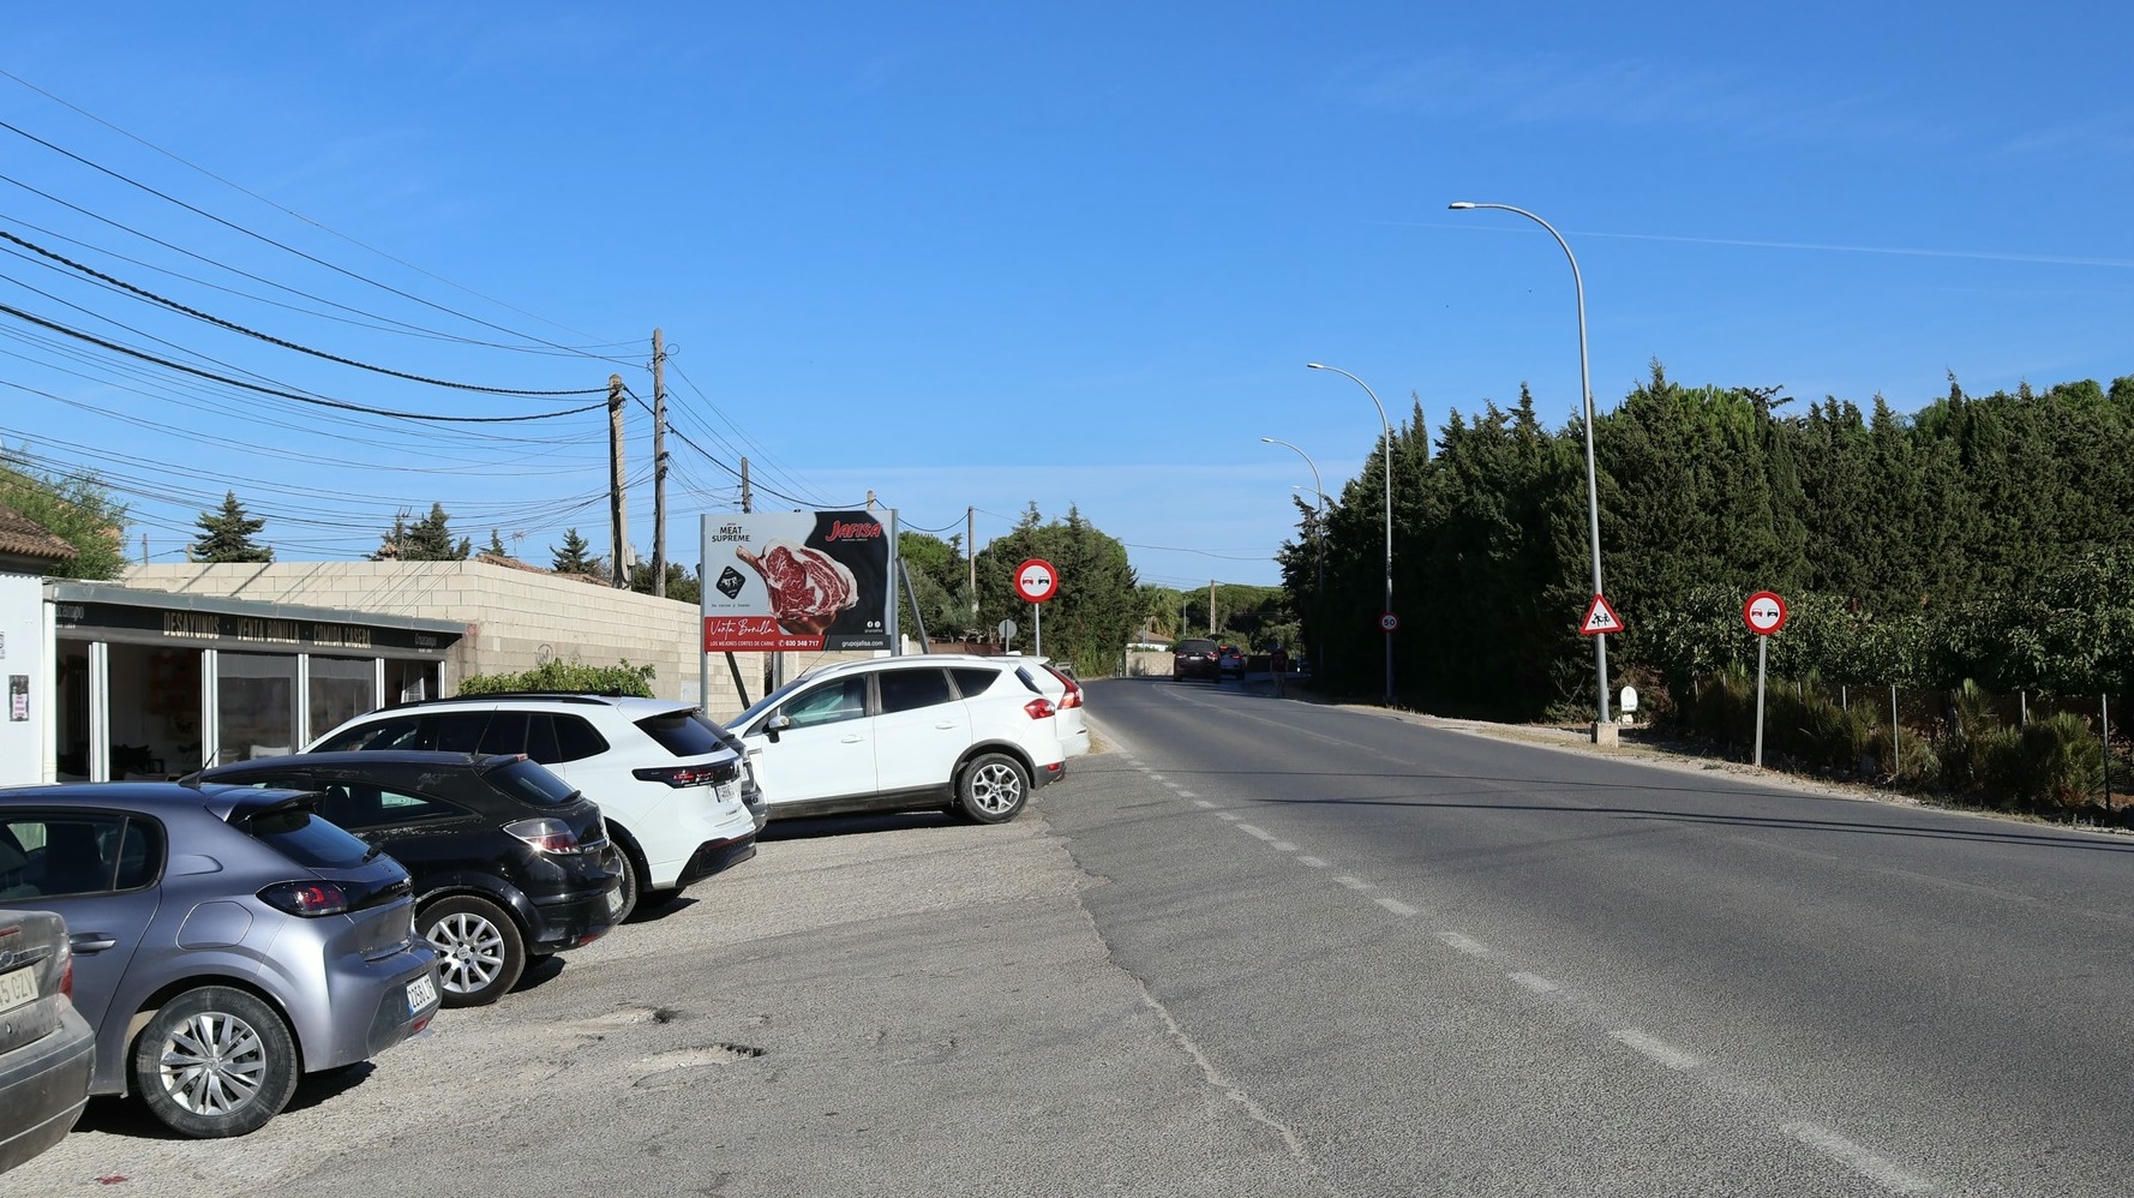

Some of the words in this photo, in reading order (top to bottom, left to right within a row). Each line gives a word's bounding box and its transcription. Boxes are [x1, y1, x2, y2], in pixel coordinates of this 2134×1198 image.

[712, 534, 751, 543] SUPREME
[720, 526, 742, 534] MEAT
[163, 611, 220, 639] DESAYUNOS
[237, 617, 264, 642] VENTA
[267, 619, 300, 644] BONILLA
[710, 619, 736, 640] Venta
[738, 618, 775, 636] Bonilla
[1384, 618, 1396, 626] 50
[313, 623, 343, 647] COMIDA
[344, 626, 372, 649] CASERA
